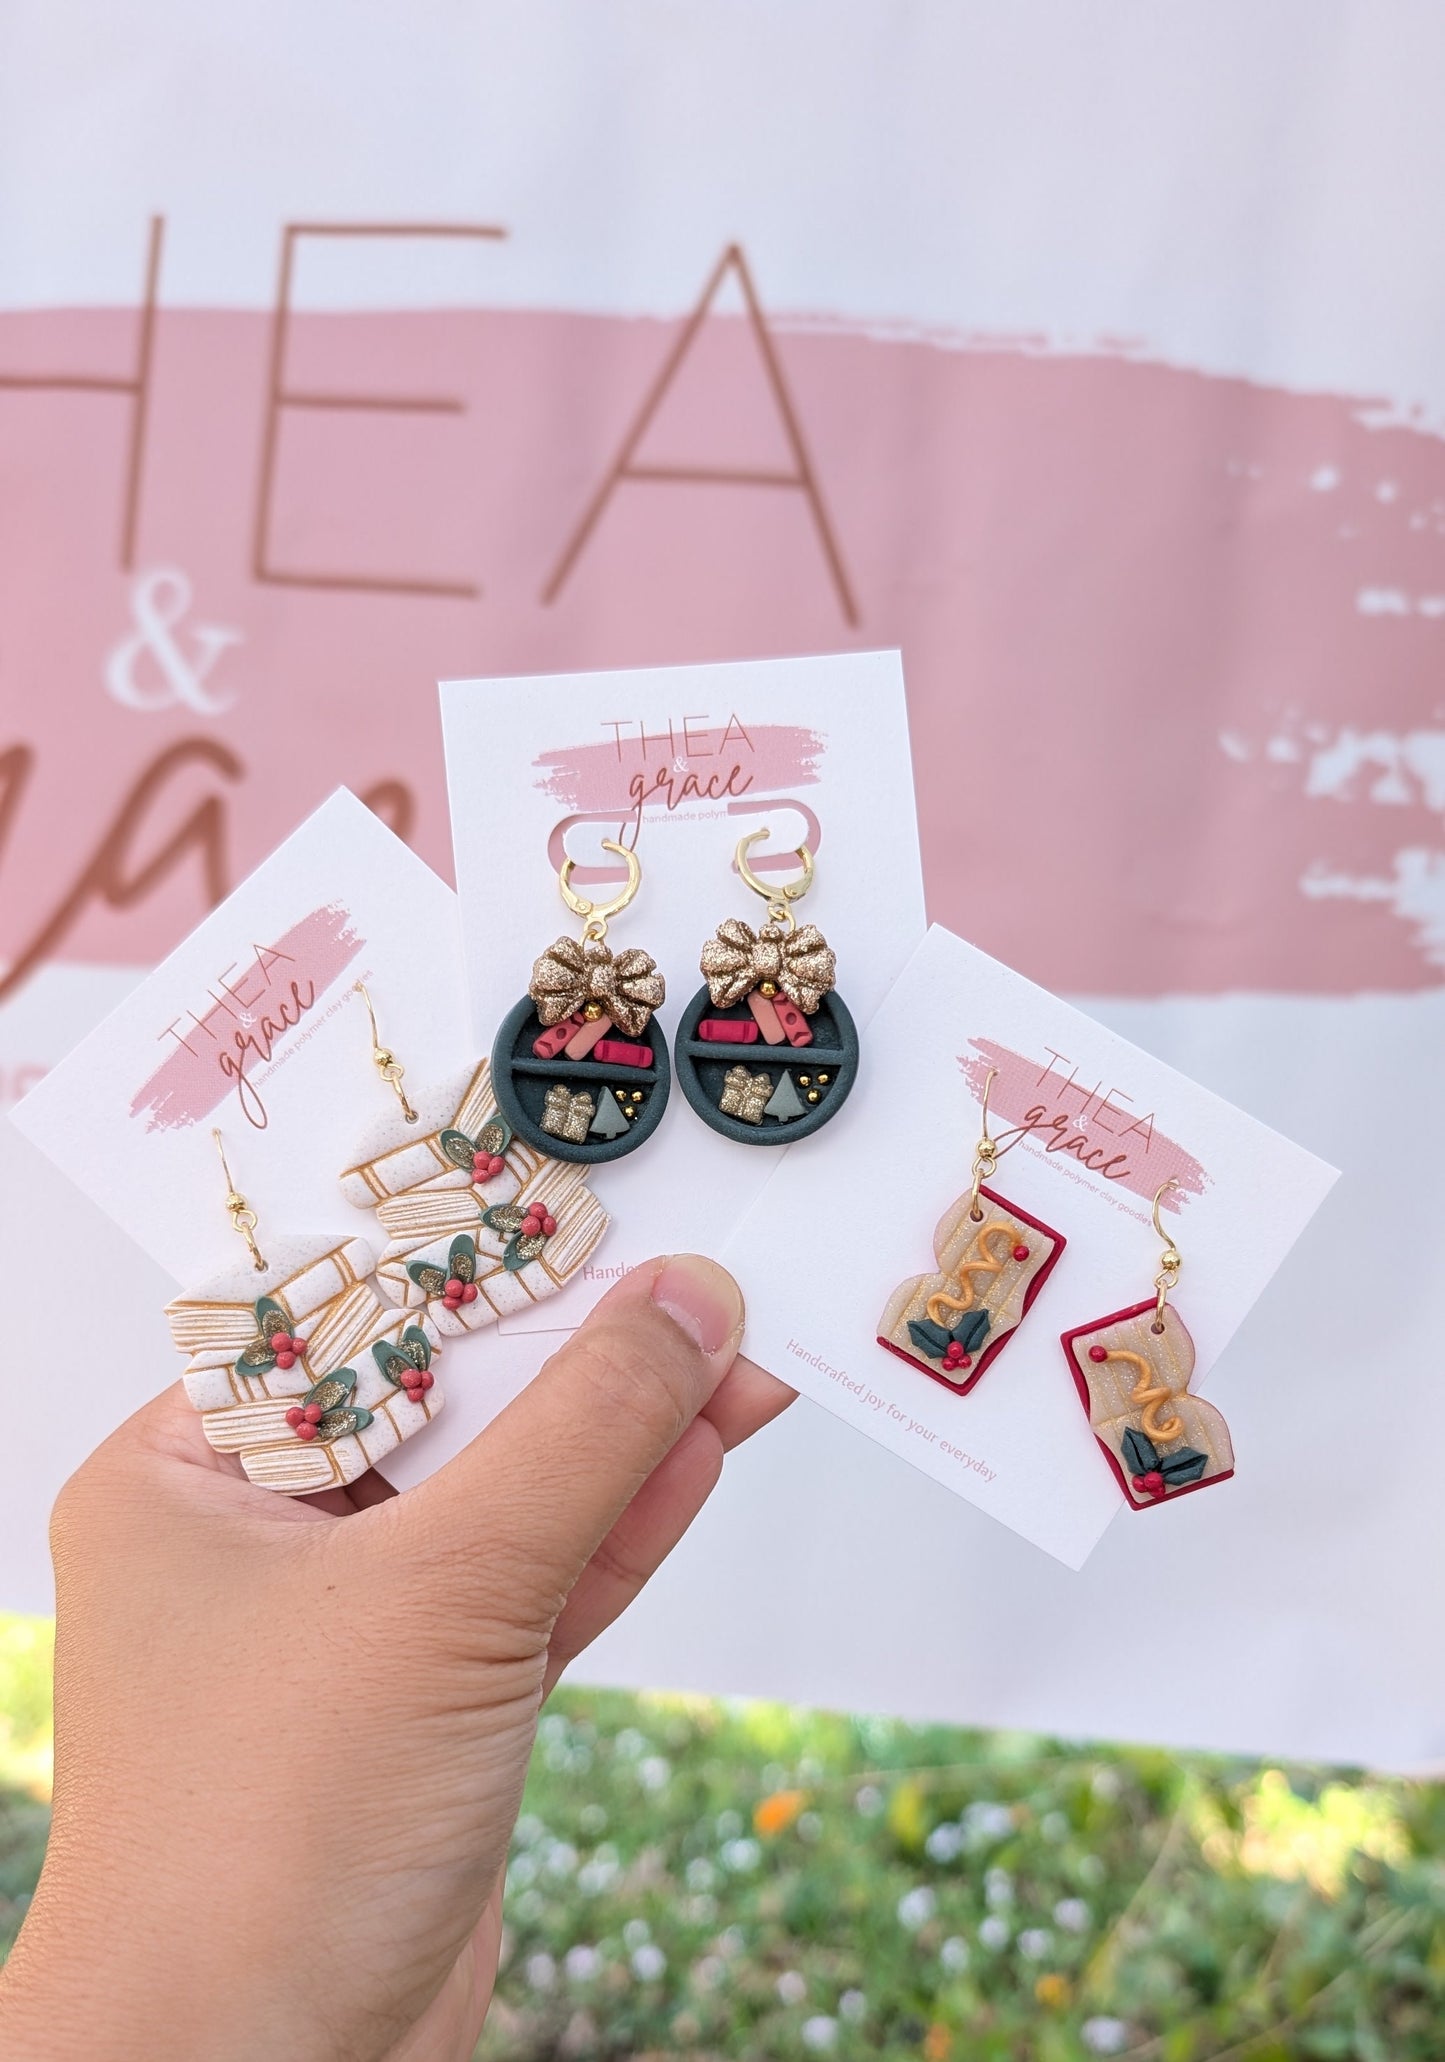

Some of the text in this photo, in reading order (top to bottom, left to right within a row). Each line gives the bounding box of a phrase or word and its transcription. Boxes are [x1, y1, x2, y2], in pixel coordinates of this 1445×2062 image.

[102, 565, 246, 718] &
[600, 713, 755, 763] THEA
[672, 757, 689, 773] &
[620, 765, 754, 851] grace
[642, 811, 696, 824] handmade
[158, 944, 295, 1058] THEA
[239, 1011, 257, 1028] &
[253, 970, 375, 1089] handmade polymer clay goies
[219, 980, 315, 1130] grace
[994, 1105, 1131, 1180] grace
[1037, 1046, 1155, 1153] THEA
[1072, 1114, 1088, 1132] &
[1018, 1140, 1153, 1227] handmade polymer clay goodies
[786, 1338, 998, 1483] Handcrafted joy for your everyday
